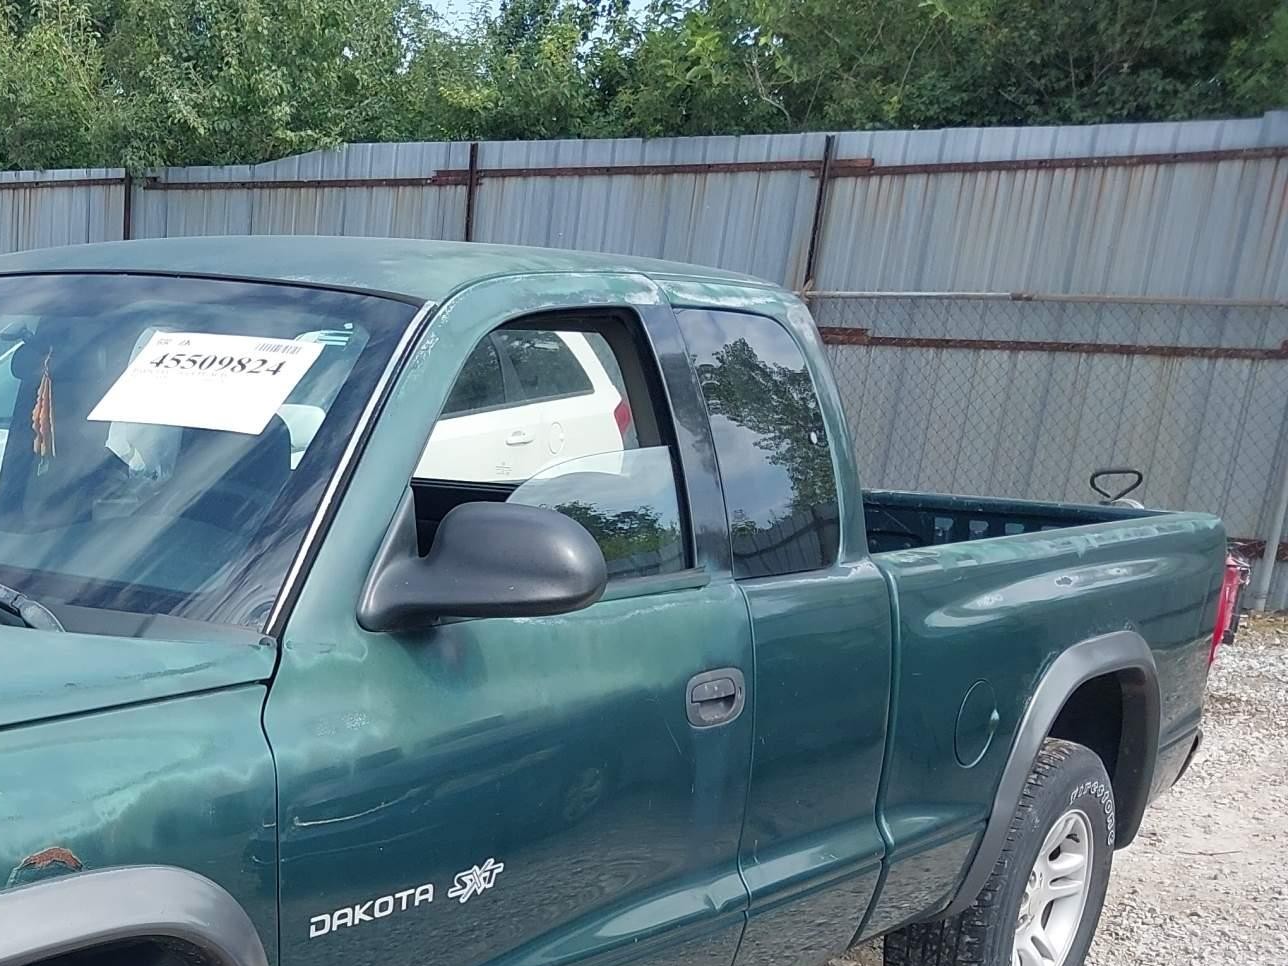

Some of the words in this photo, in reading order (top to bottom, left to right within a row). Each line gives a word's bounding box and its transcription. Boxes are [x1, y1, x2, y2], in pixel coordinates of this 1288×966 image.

[150, 352, 286, 376] 45509824
[309, 883, 435, 939] DAKOTA
[447, 857, 505, 904] SXT
